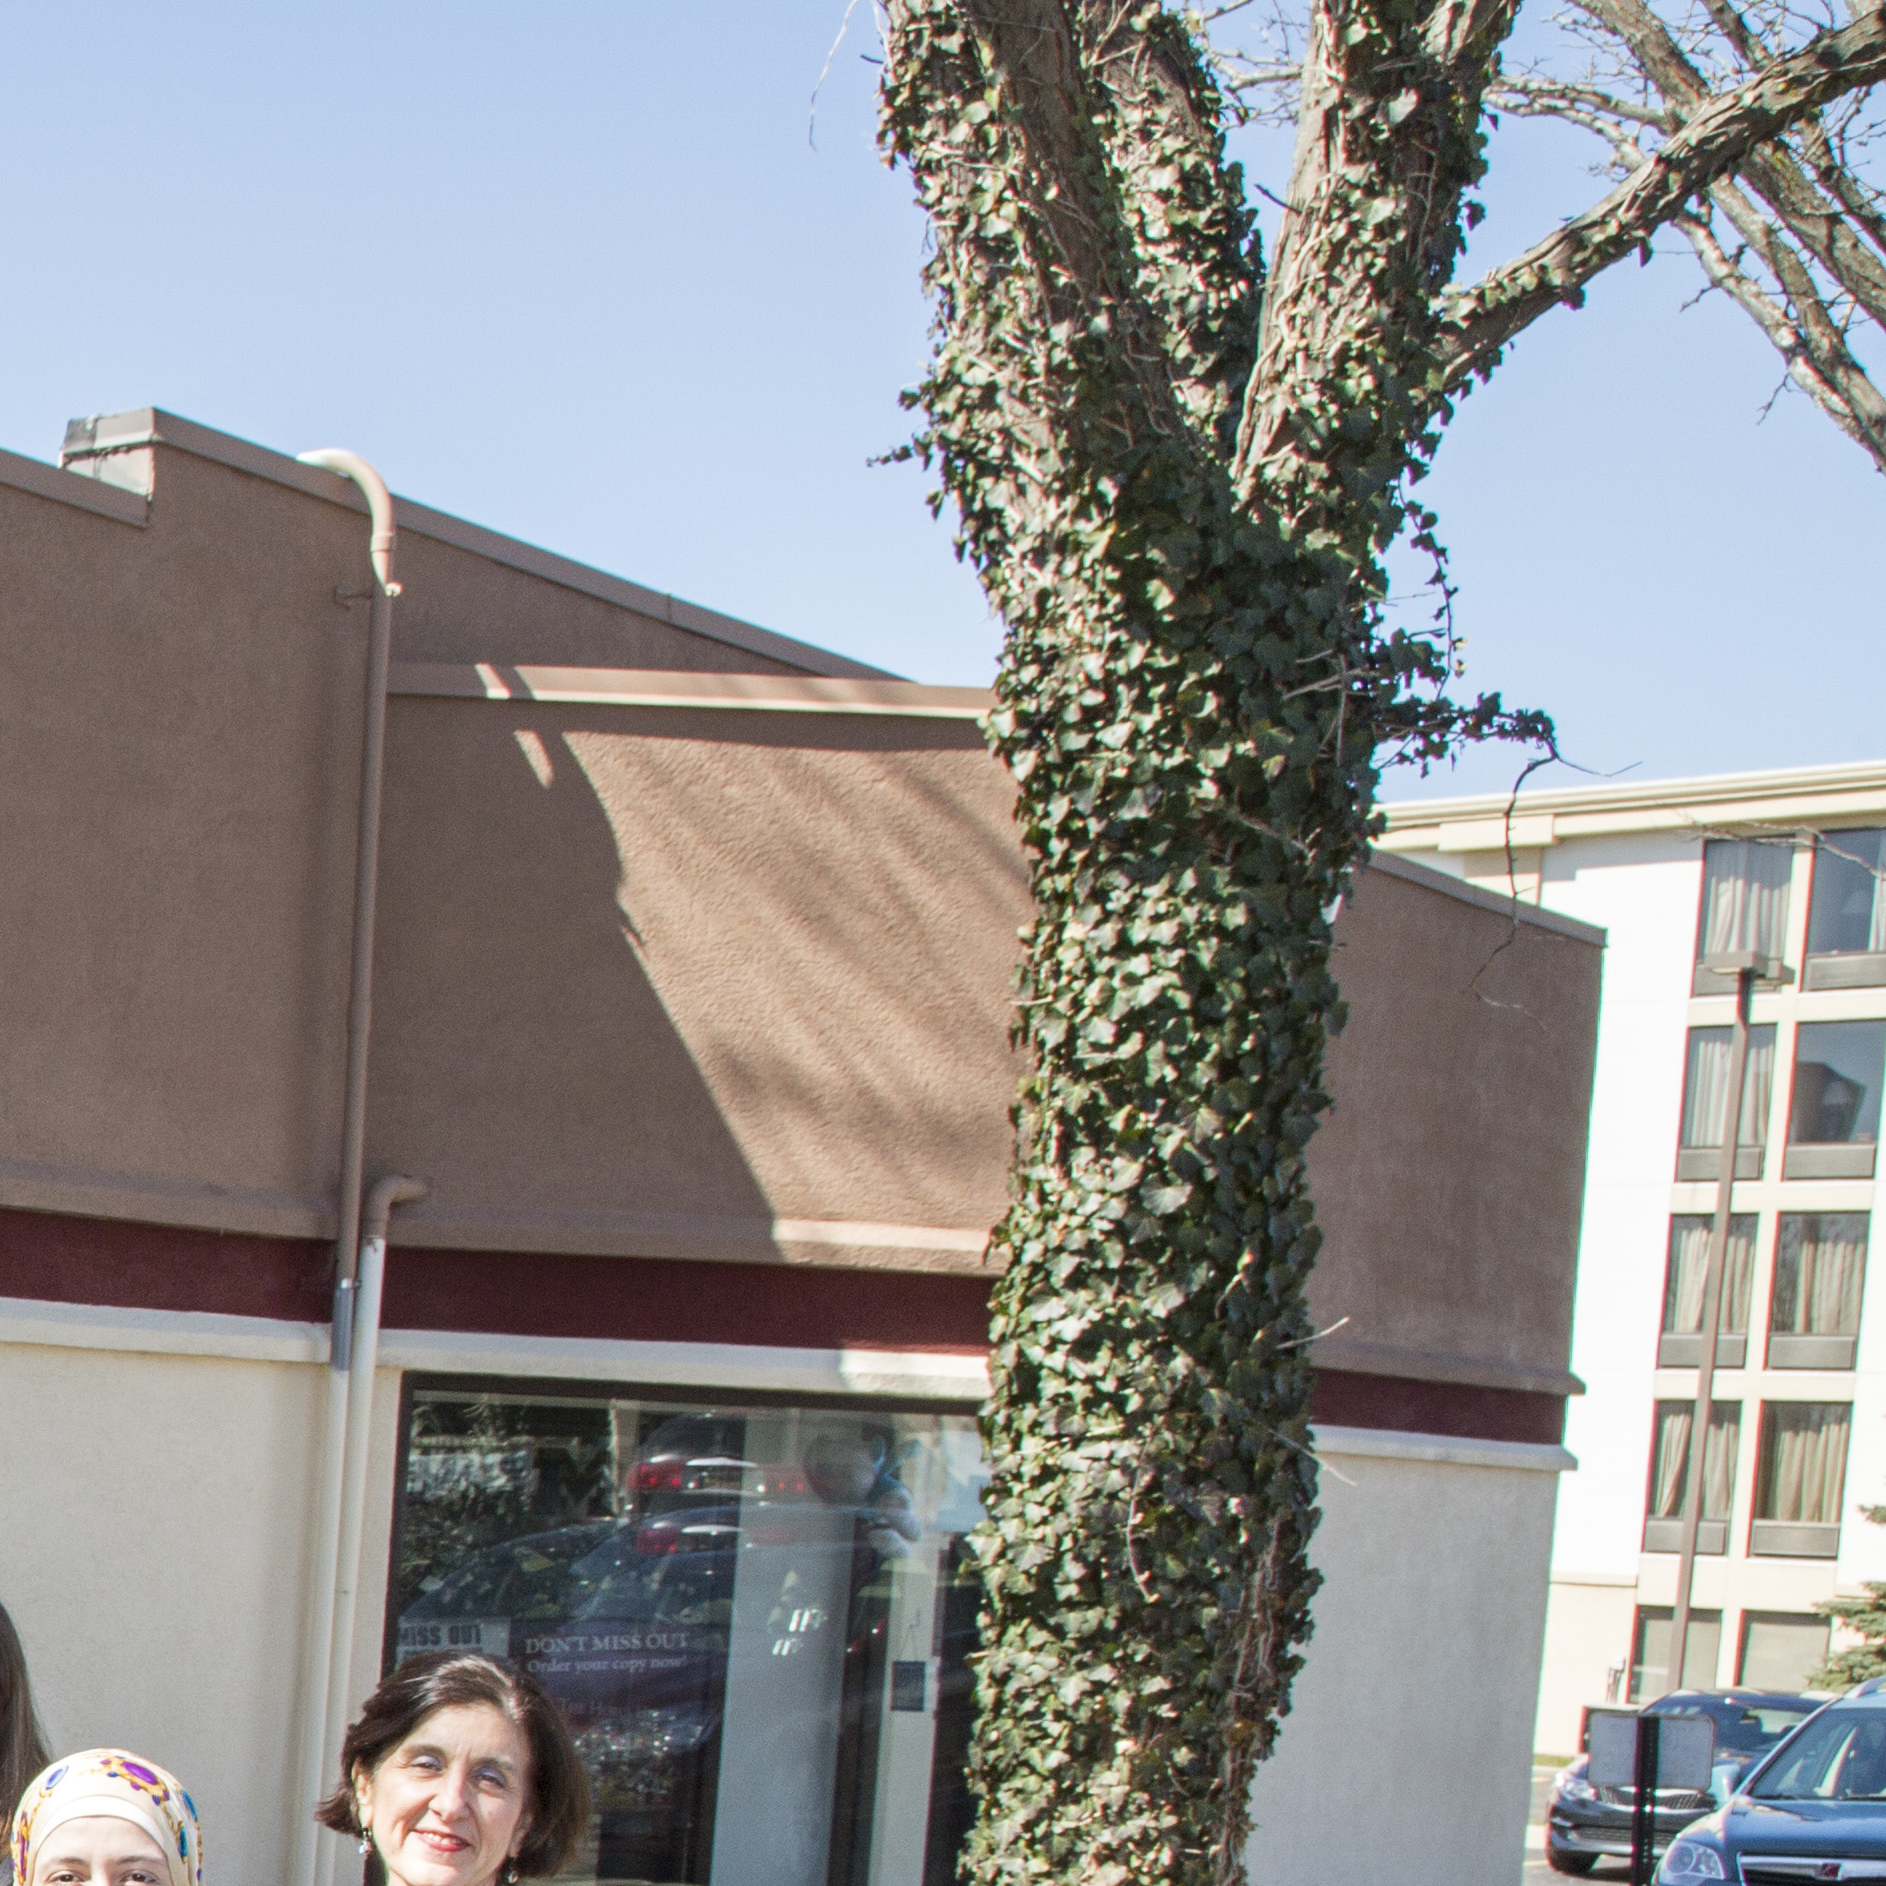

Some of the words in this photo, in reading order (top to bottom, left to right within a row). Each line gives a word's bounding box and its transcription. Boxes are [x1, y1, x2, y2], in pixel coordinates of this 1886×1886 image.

[525, 1636, 588, 1654] DON'T
[591, 1633, 642, 1651] MISS
[645, 1631, 689, 1649] OUT
[527, 1659, 570, 1673] Order
[574, 1660, 609, 1674] your
[612, 1659, 647, 1673] copy
